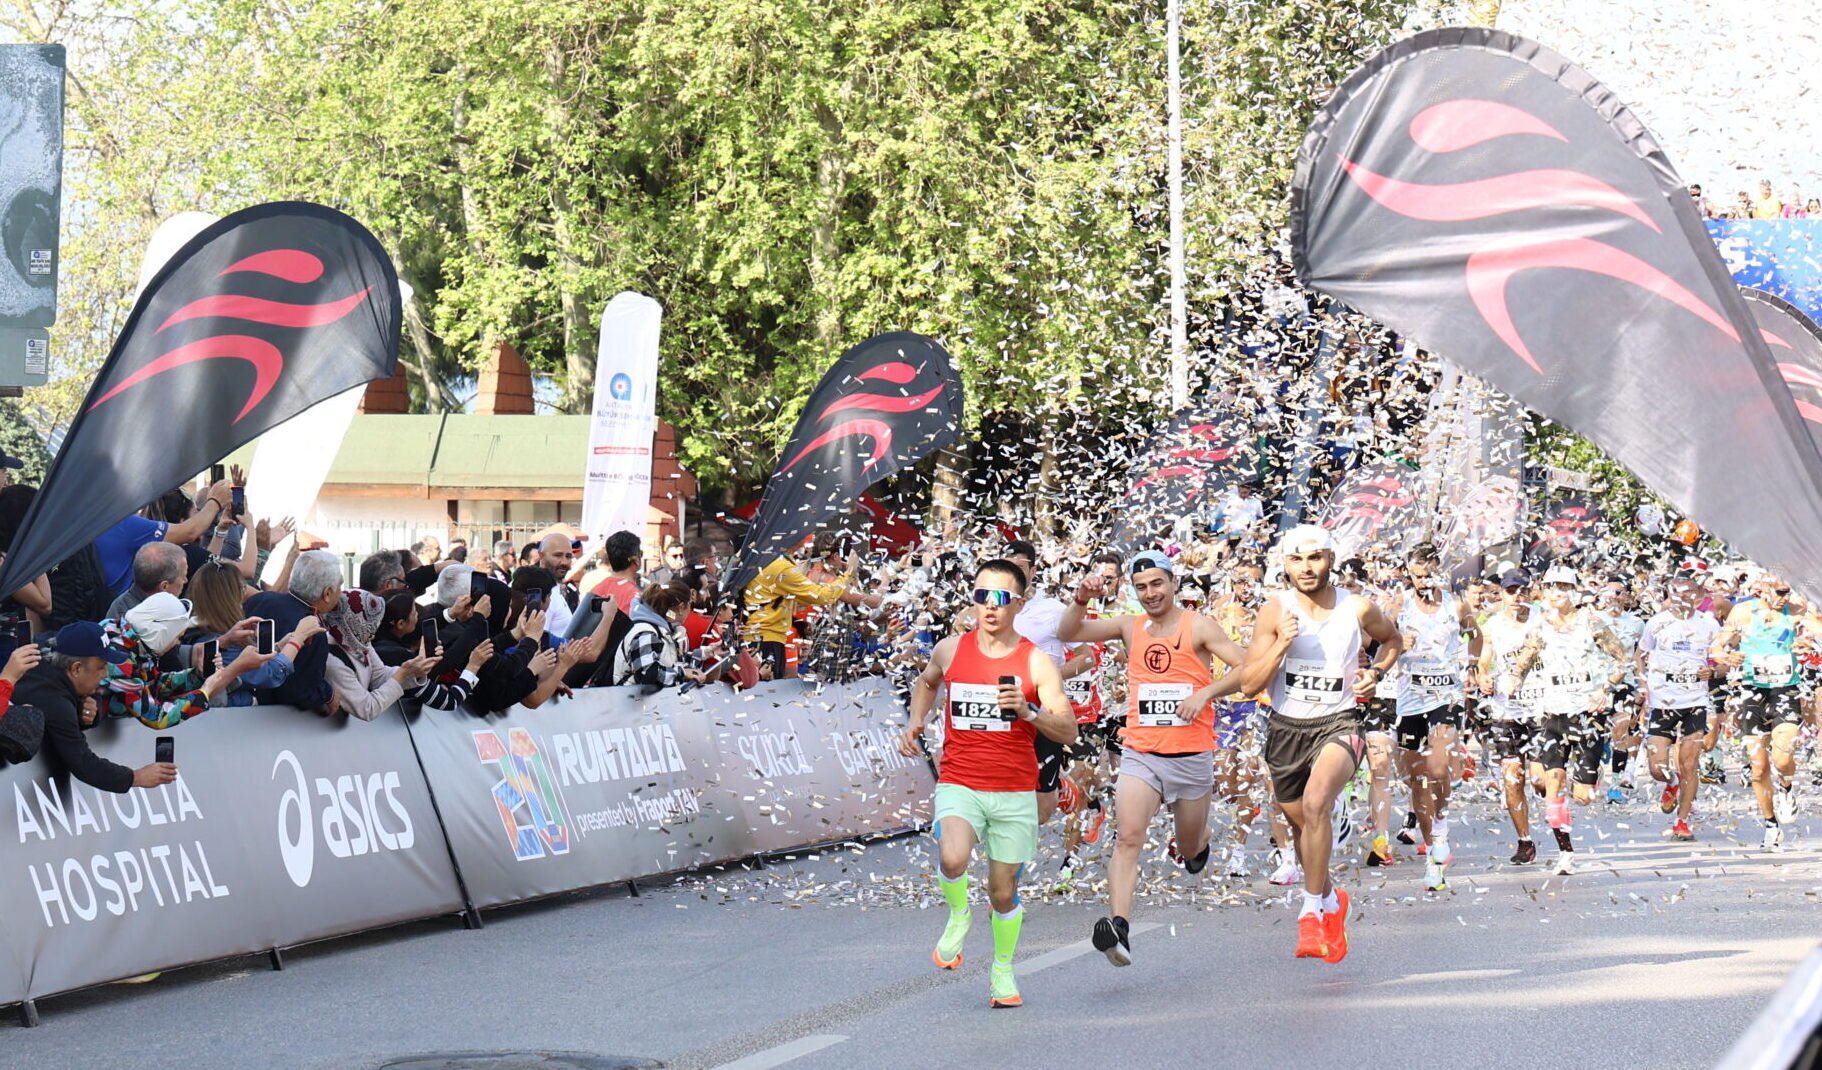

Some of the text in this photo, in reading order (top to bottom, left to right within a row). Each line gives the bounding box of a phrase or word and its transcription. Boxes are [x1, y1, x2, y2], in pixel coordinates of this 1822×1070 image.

[1293, 675, 1337, 691] 2147
[1418, 675, 1450, 686] 1000
[958, 702, 1001, 718] 1824
[552, 724, 687, 787] RUNTALYA
[831, 728, 919, 776] GARMI
[576, 801, 627, 838] presented
[621, 801, 640, 830] by
[633, 792, 679, 826] Fraport
[28, 841, 230, 927] HOSPITAL
